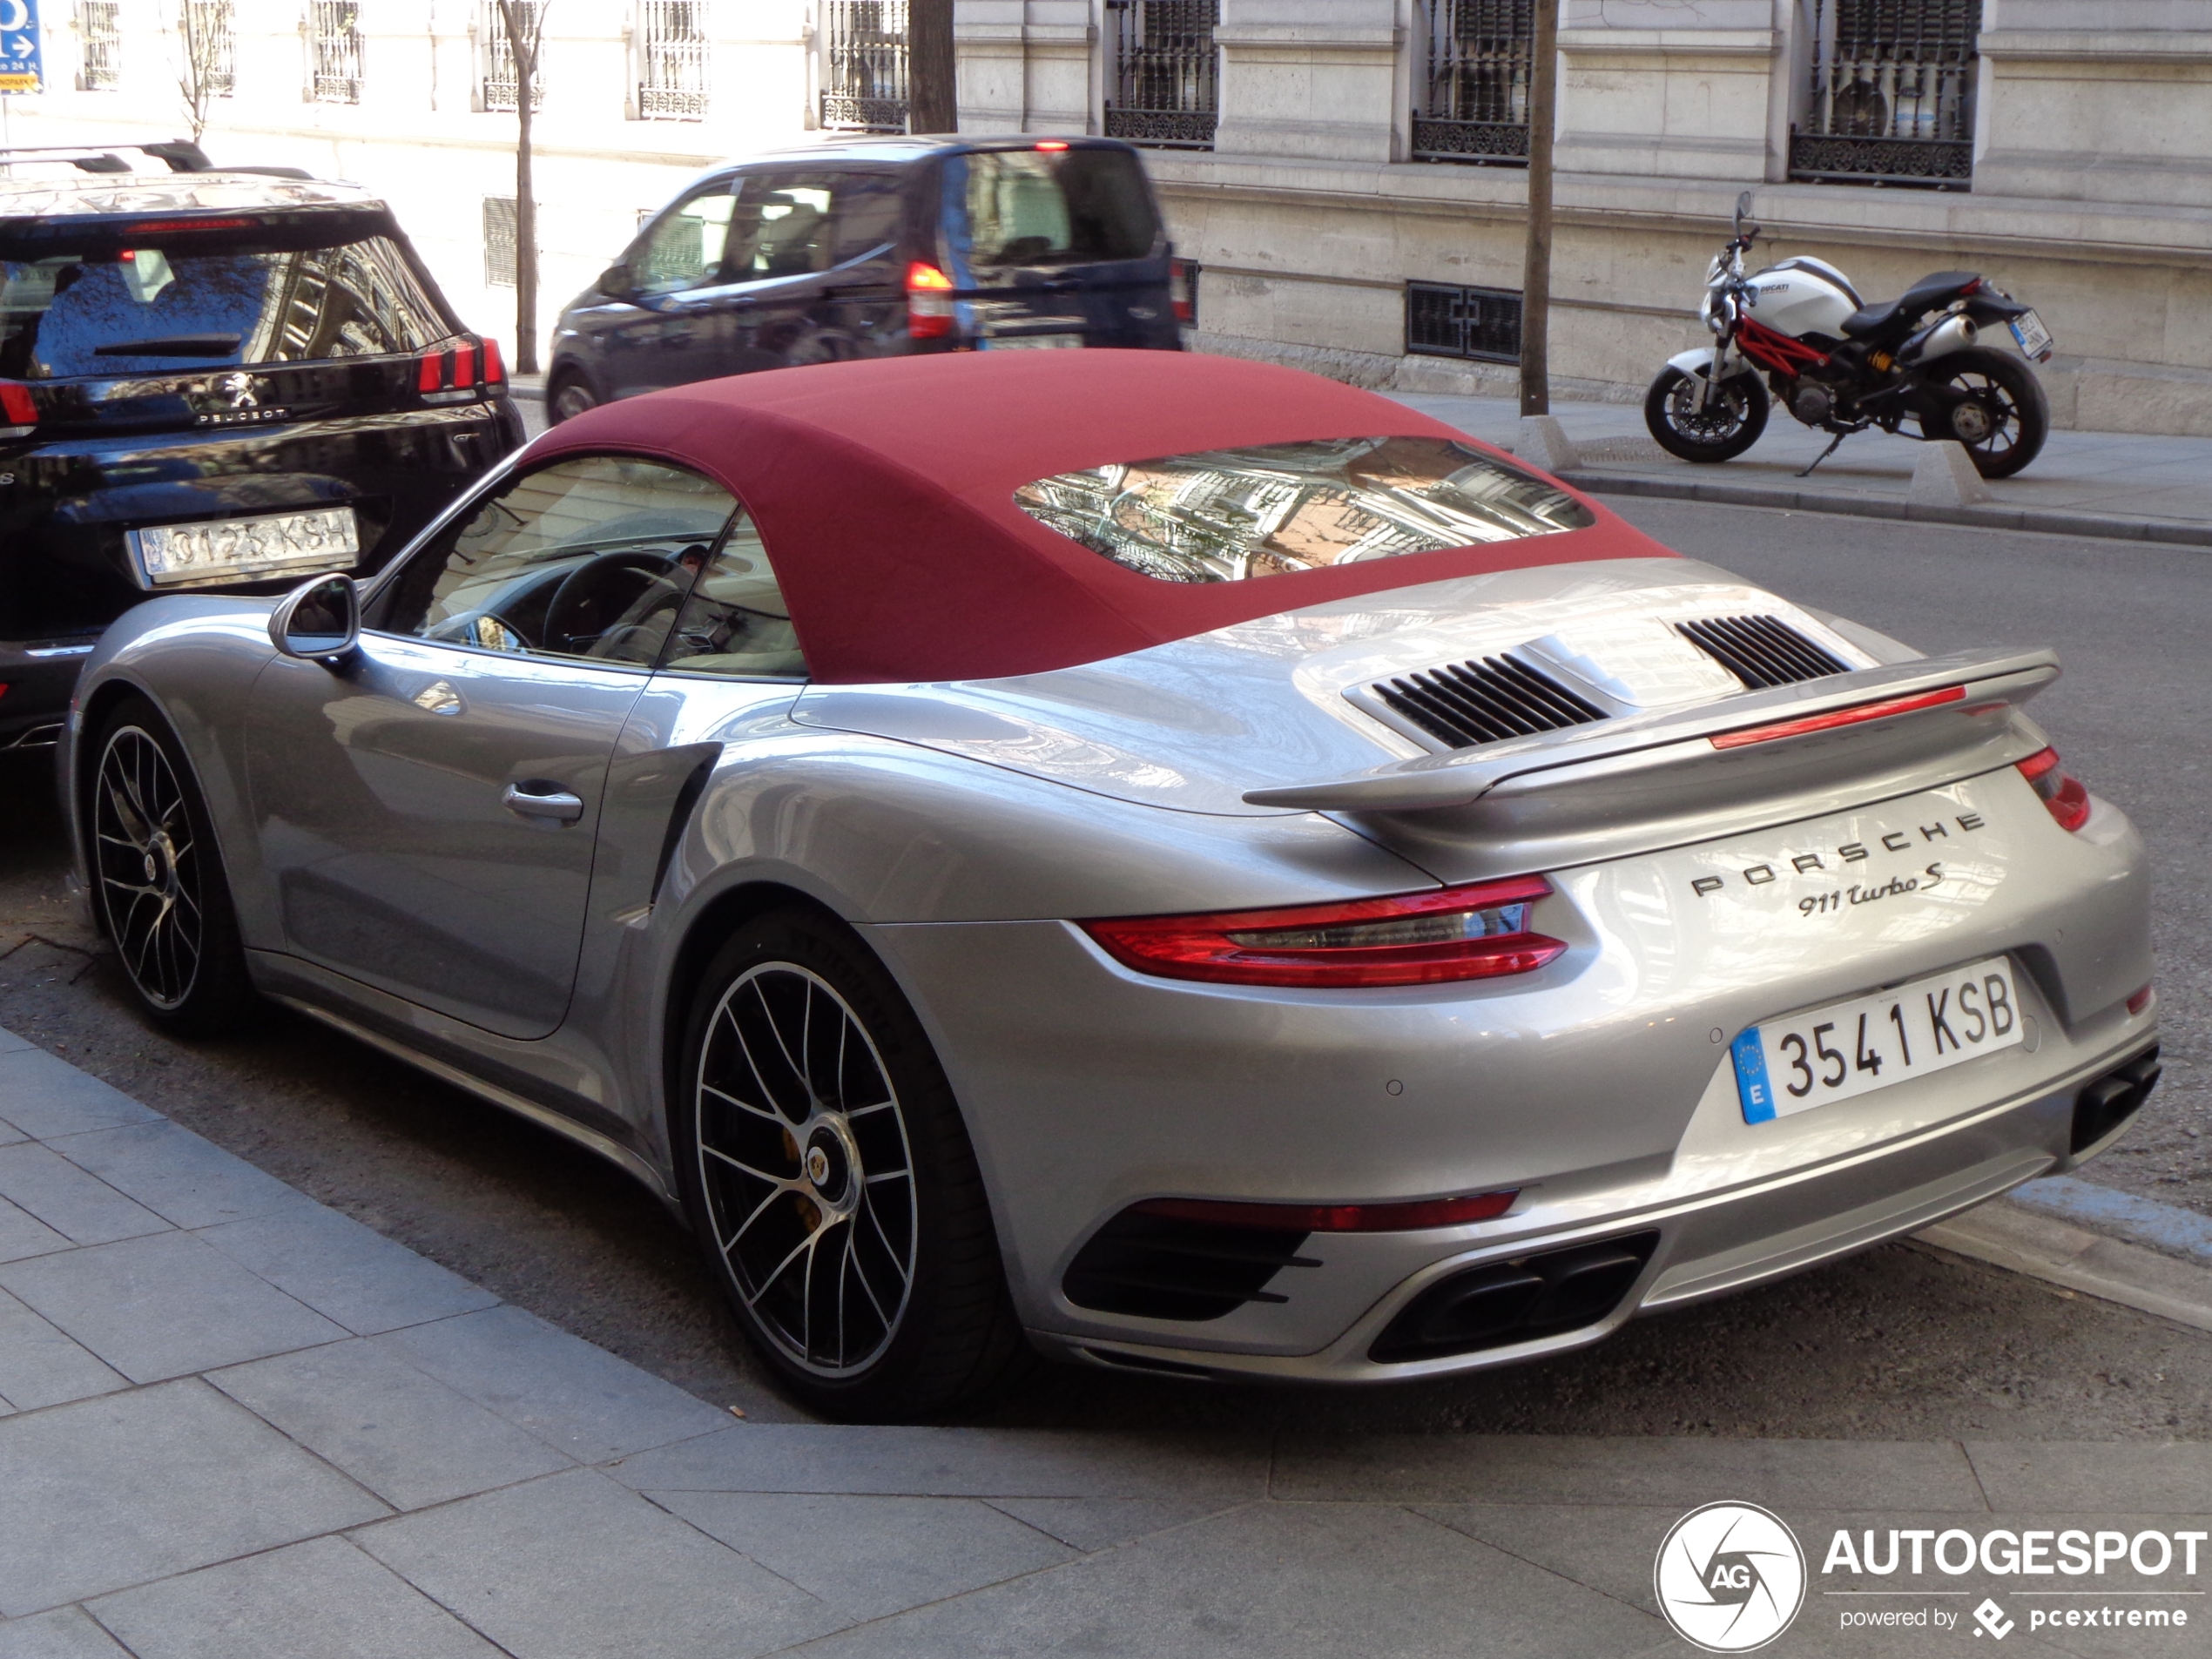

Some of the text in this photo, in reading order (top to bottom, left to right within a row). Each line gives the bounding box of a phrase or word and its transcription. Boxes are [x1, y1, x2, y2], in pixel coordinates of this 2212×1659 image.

[11, 61, 24, 70] 24
[1760, 284, 1790, 293] DUCATI
[199, 408, 285, 422] PEUGEOT
[1691, 813, 1986, 897] PORSCHE
[1798, 862, 1945, 917] 911 Turbo S
[1750, 974, 2013, 1105] E 3541 KSB
